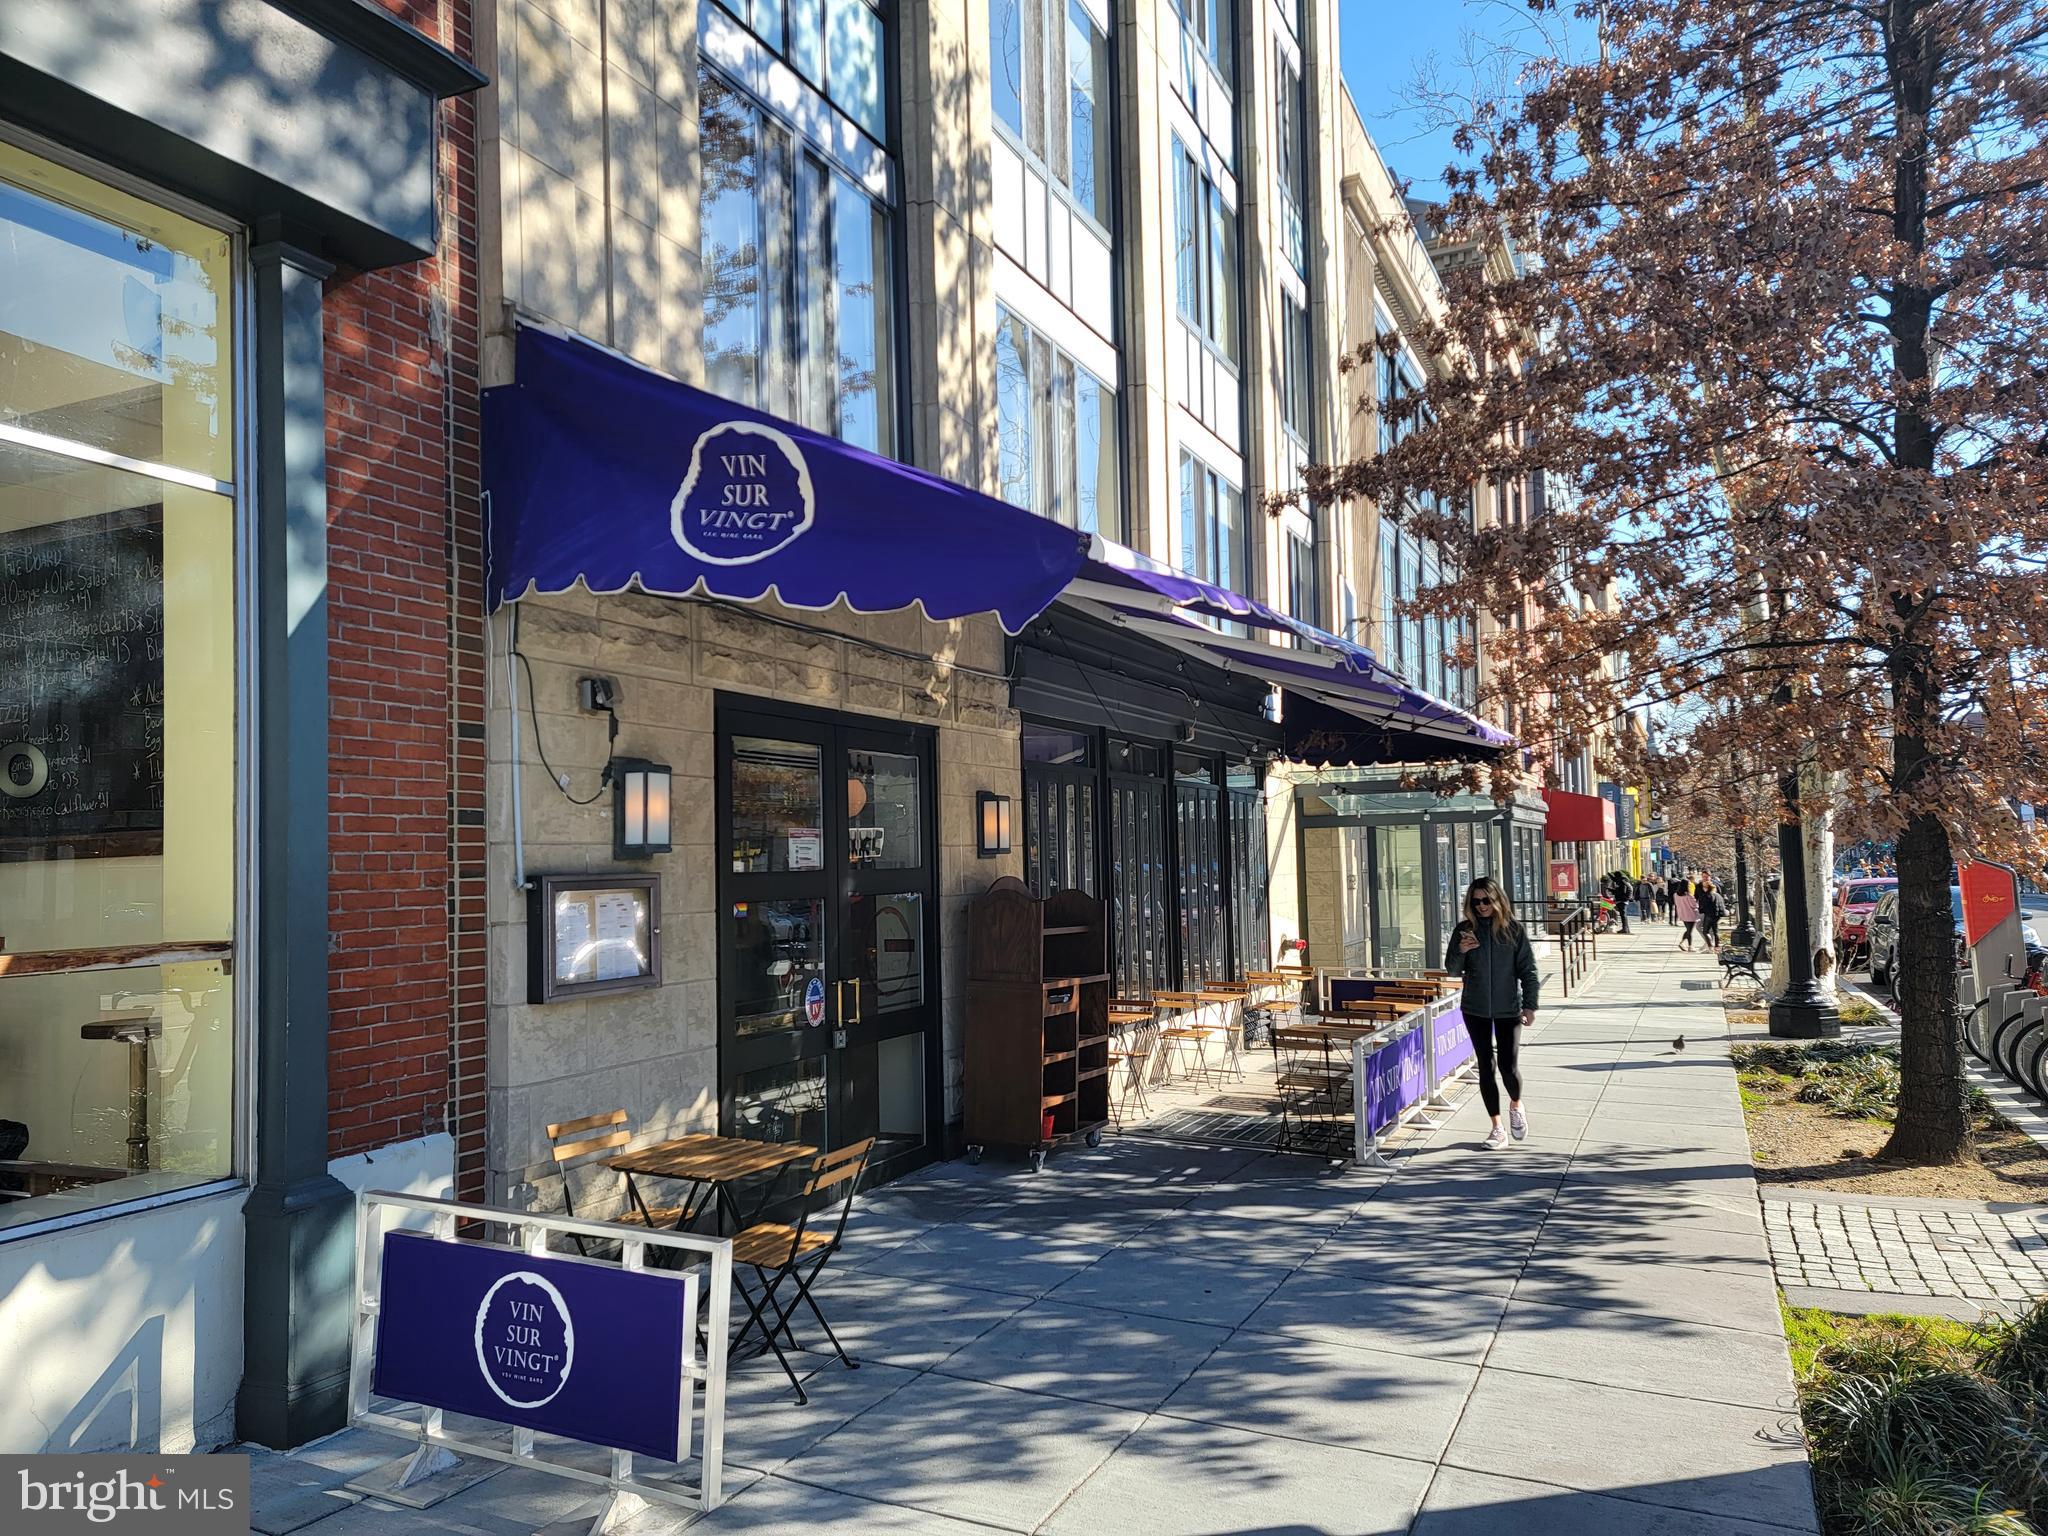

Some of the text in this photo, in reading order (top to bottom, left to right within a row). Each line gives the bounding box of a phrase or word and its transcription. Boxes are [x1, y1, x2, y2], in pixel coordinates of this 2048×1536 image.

[720, 454, 767, 477] VIN
[721, 484, 769, 507] SUR
[699, 509, 787, 531] VINGT
[1370, 1071, 1386, 1105] VIN
[1387, 1064, 1401, 1096] SUR
[510, 1301, 544, 1323] VIN
[506, 1324, 542, 1348] SUR
[494, 1345, 554, 1374] VINGT
